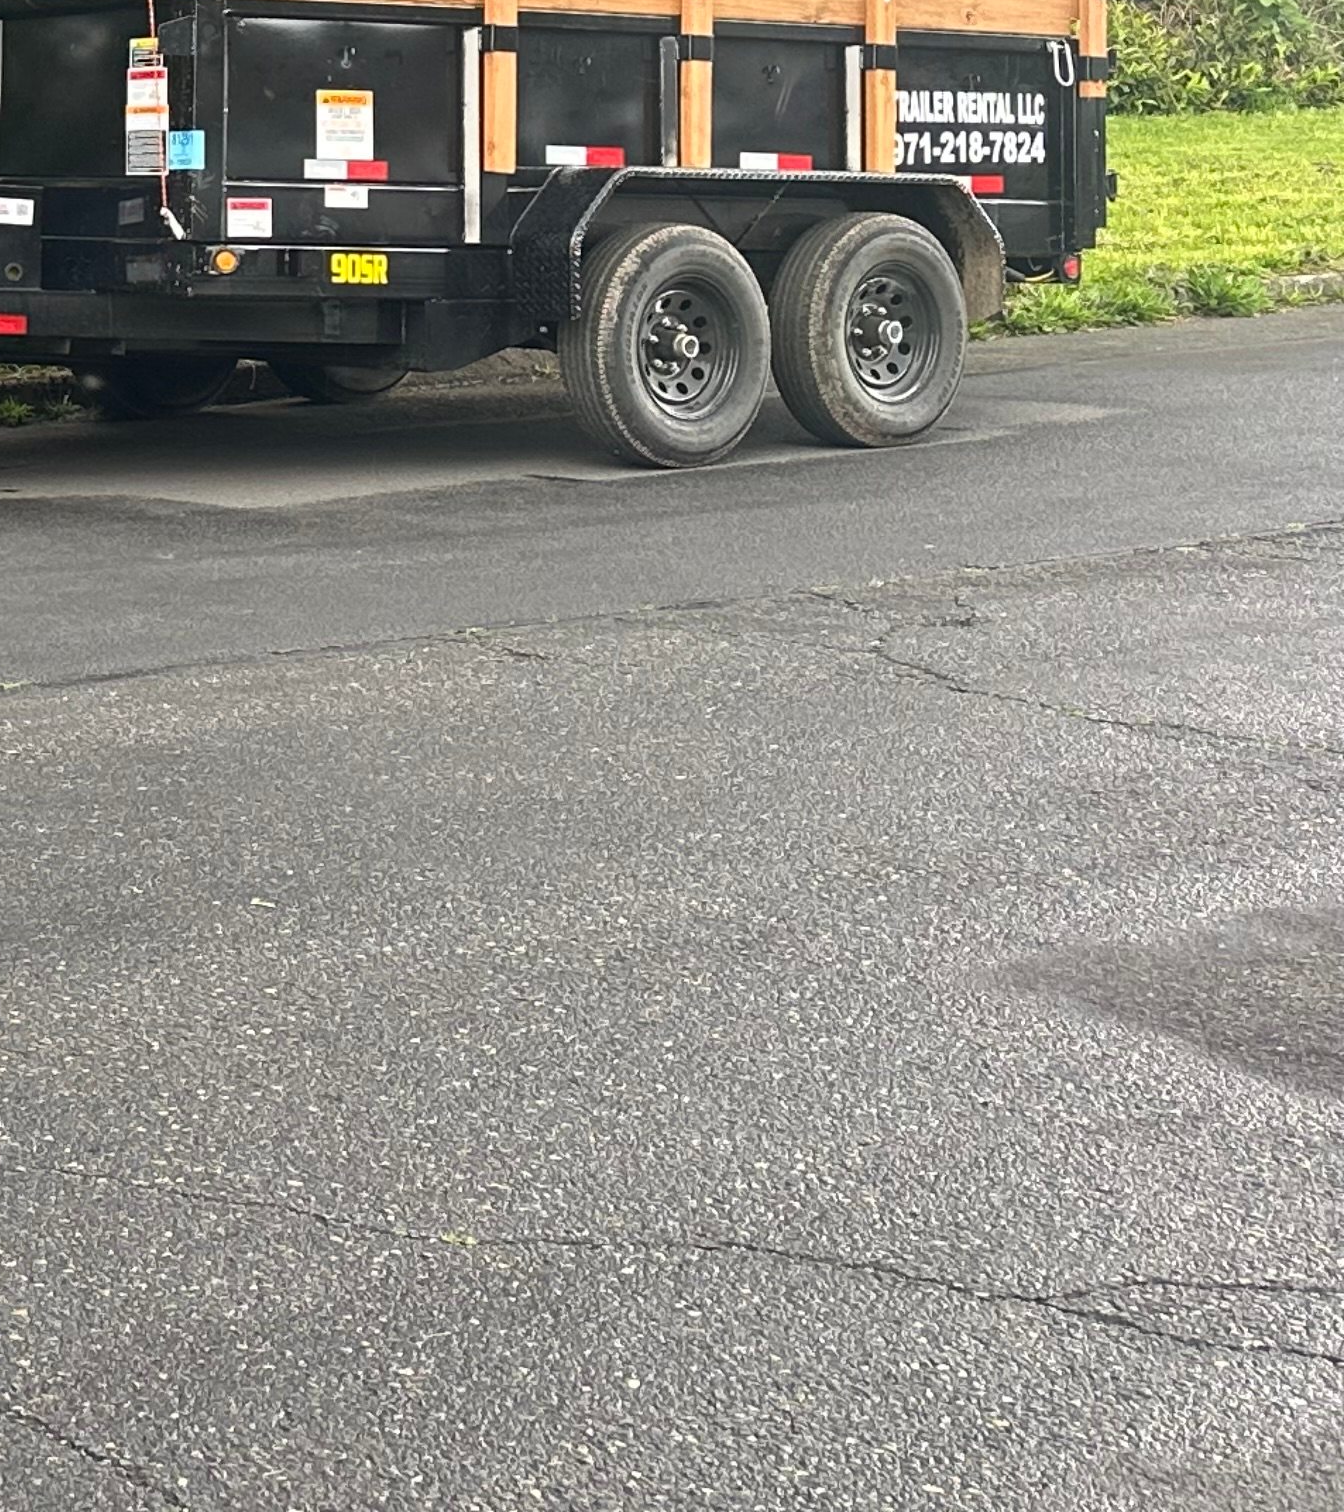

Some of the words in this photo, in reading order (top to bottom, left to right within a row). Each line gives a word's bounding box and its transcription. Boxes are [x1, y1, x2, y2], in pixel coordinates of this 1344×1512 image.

[895, 90, 955, 123] RAILER
[956, 91, 1016, 124] RENTAL
[1017, 92, 1046, 126] LLC
[330, 252, 389, 285] 90SR
